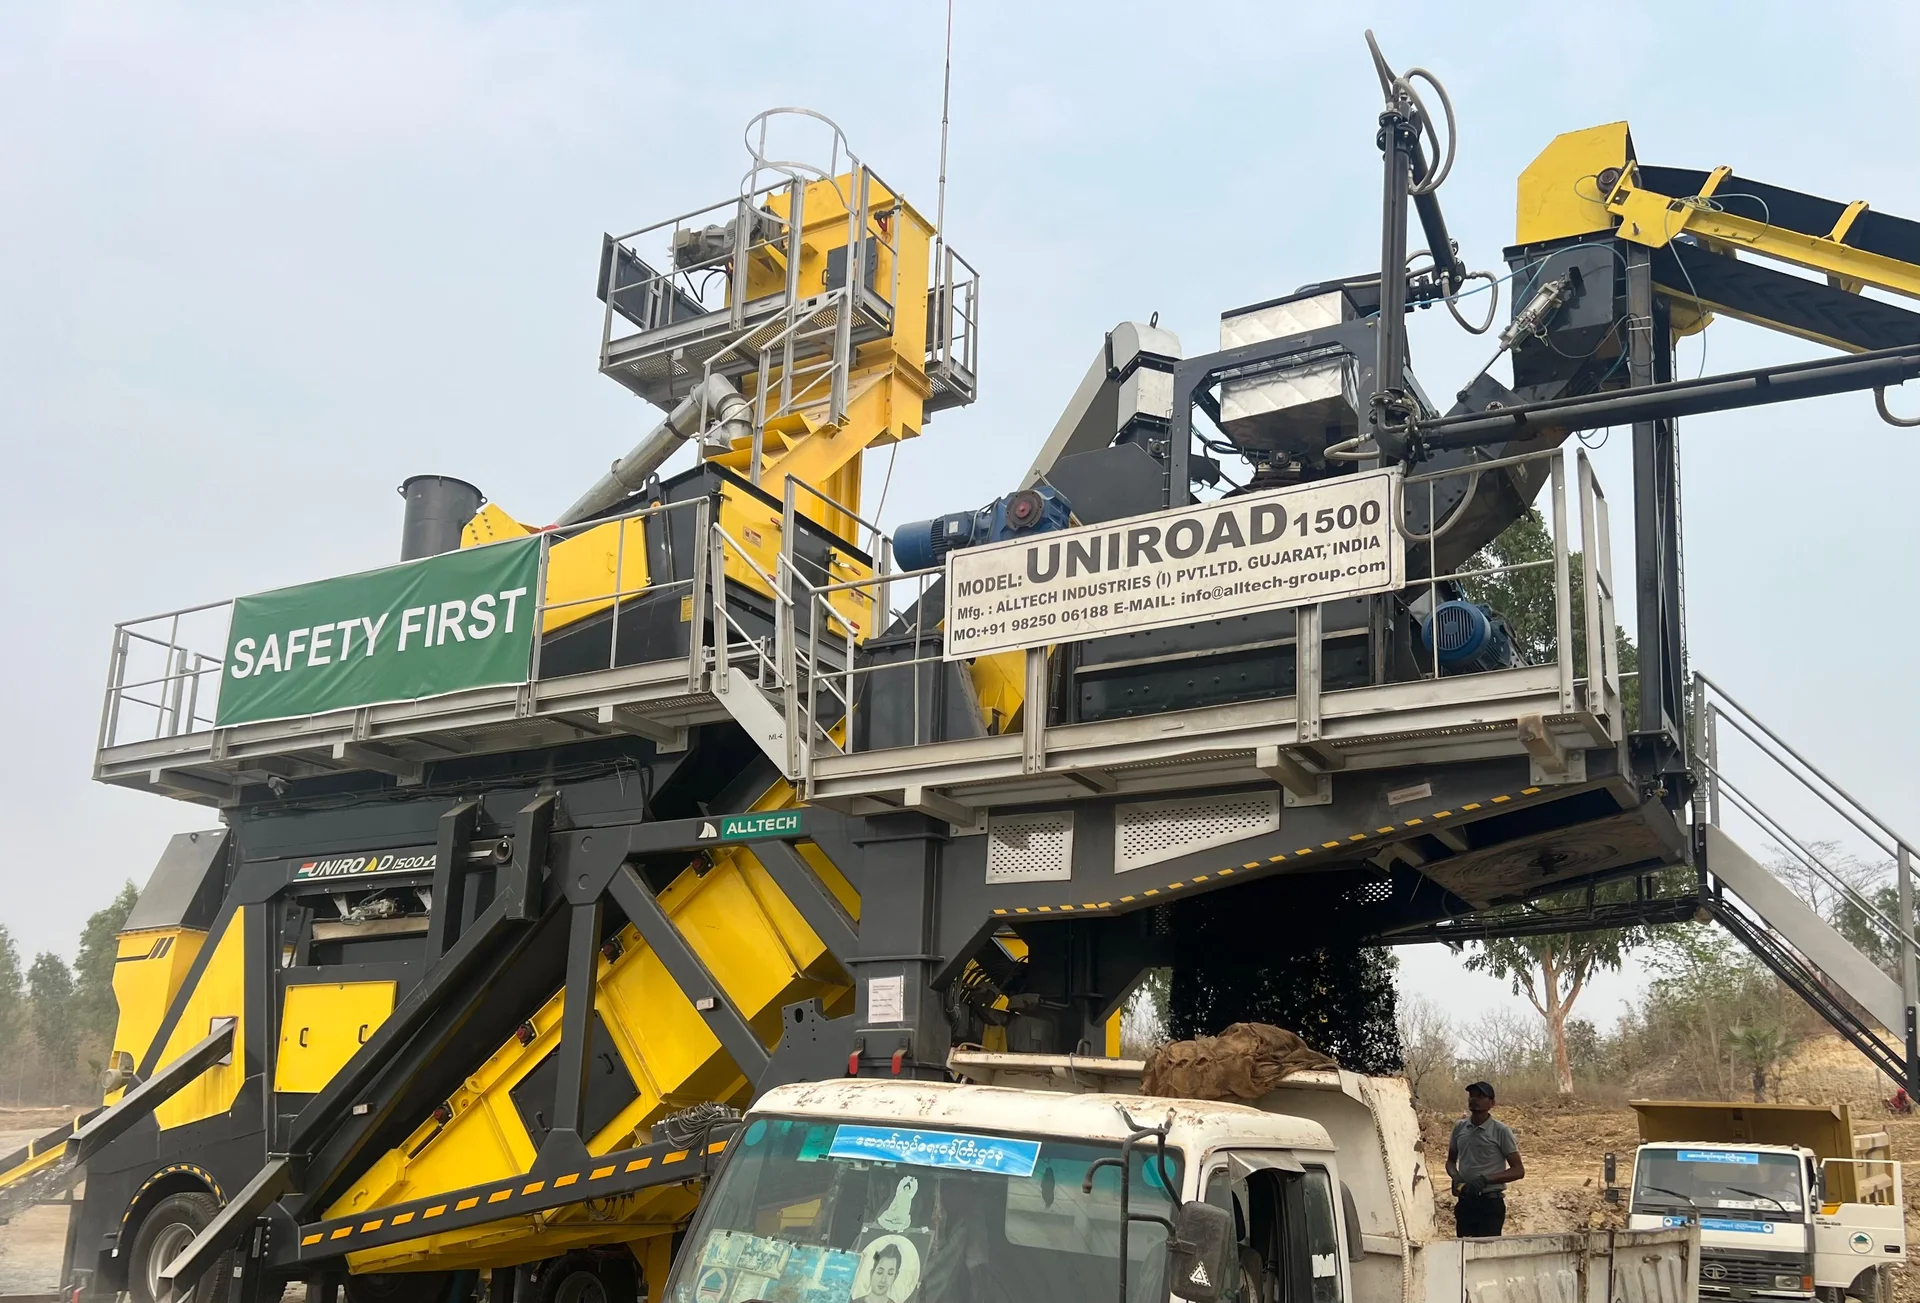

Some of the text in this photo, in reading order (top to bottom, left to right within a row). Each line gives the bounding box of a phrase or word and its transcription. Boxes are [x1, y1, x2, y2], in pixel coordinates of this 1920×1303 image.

[958, 500, 1381, 598] MODEL: UNIROAD 1500
[958, 606, 984, 620] Mfg.
[996, 591, 1058, 614] ALLTECH
[1062, 575, 1152, 602] INDUSTRIES
[1155, 571, 1172, 589] (I)
[1176, 560, 1243, 584] PVT.LTD.
[1247, 544, 1328, 570] GUJARAT,
[1332, 535, 1381, 555] INDIA
[230, 586, 527, 679] SAFETY FIRST
[953, 559, 1386, 641] MO:+91 98250 06188 E-MAIL: info@alltech-group.com
[726, 816, 797, 835] ALLTECH
